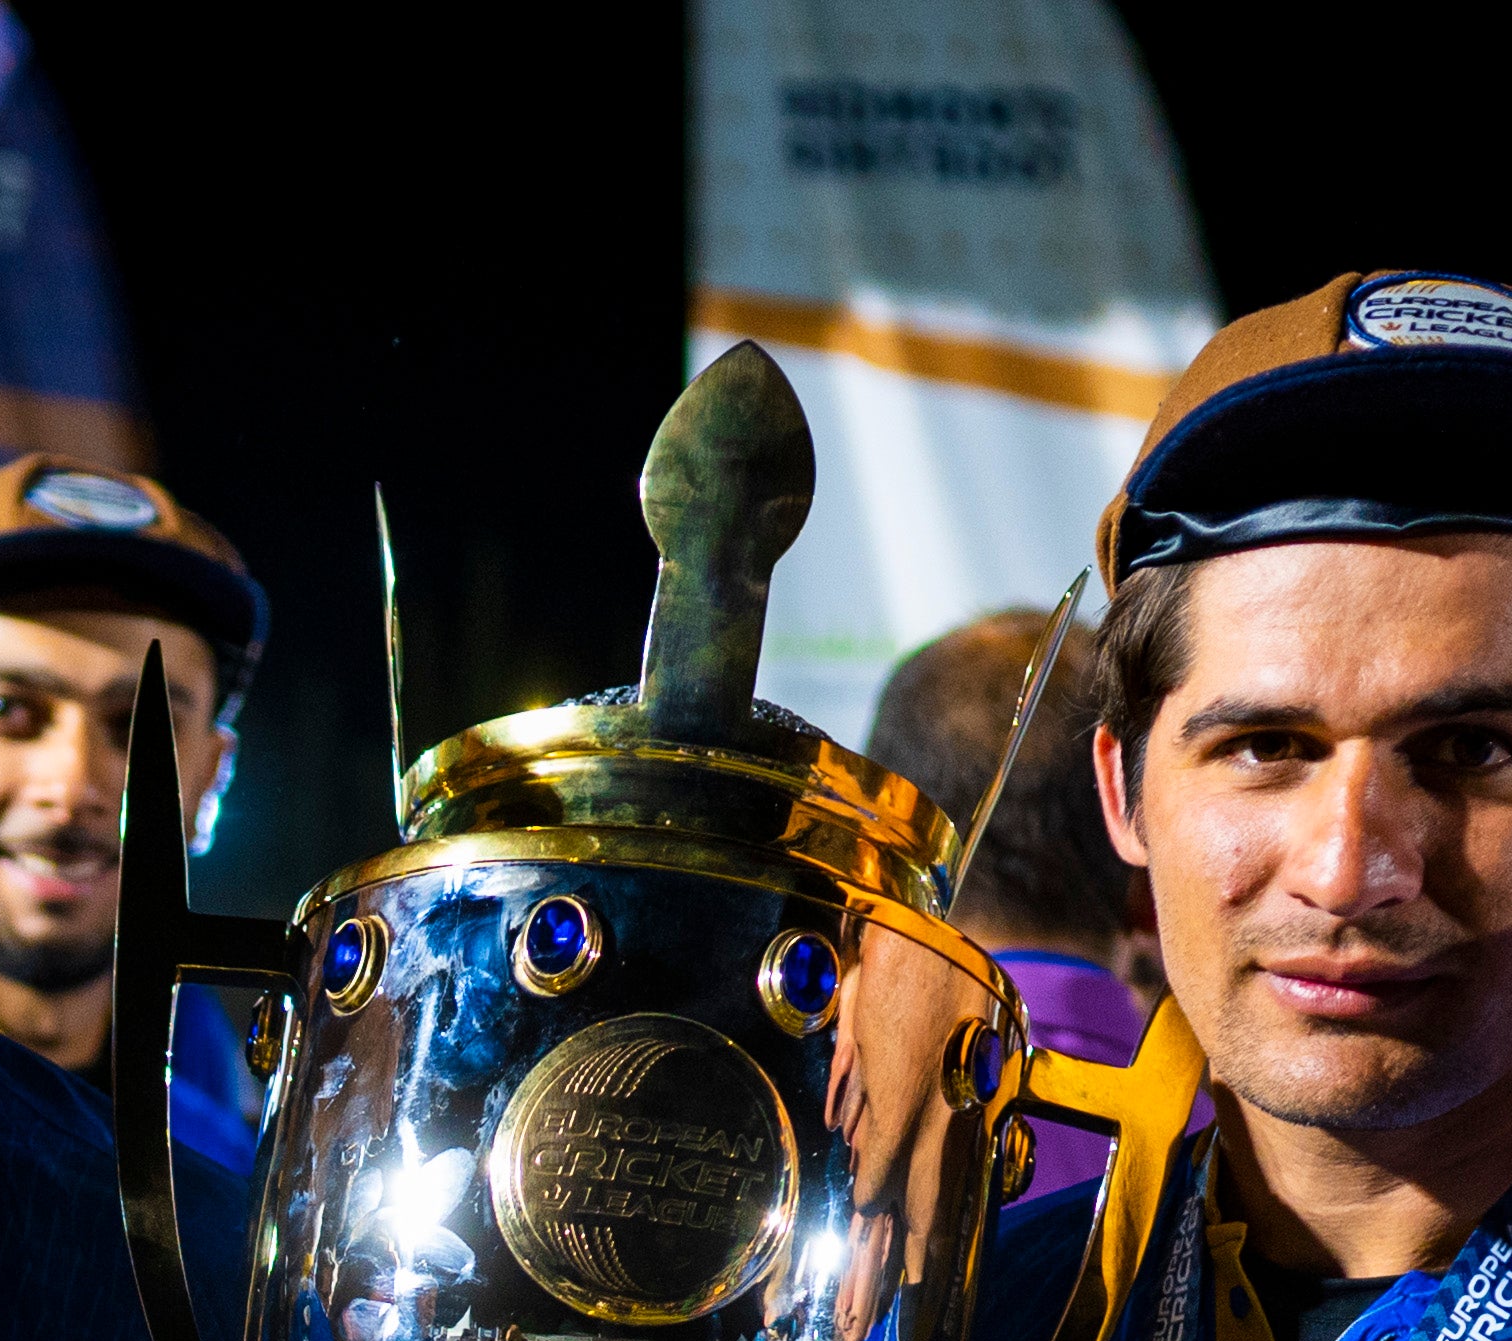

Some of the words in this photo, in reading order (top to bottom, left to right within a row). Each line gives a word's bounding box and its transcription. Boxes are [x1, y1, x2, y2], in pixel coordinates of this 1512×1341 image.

[539, 1109, 765, 1162] EUROPEAN
[529, 1143, 766, 1201] CRICKET
[576, 1187, 738, 1235] LEAGUE
